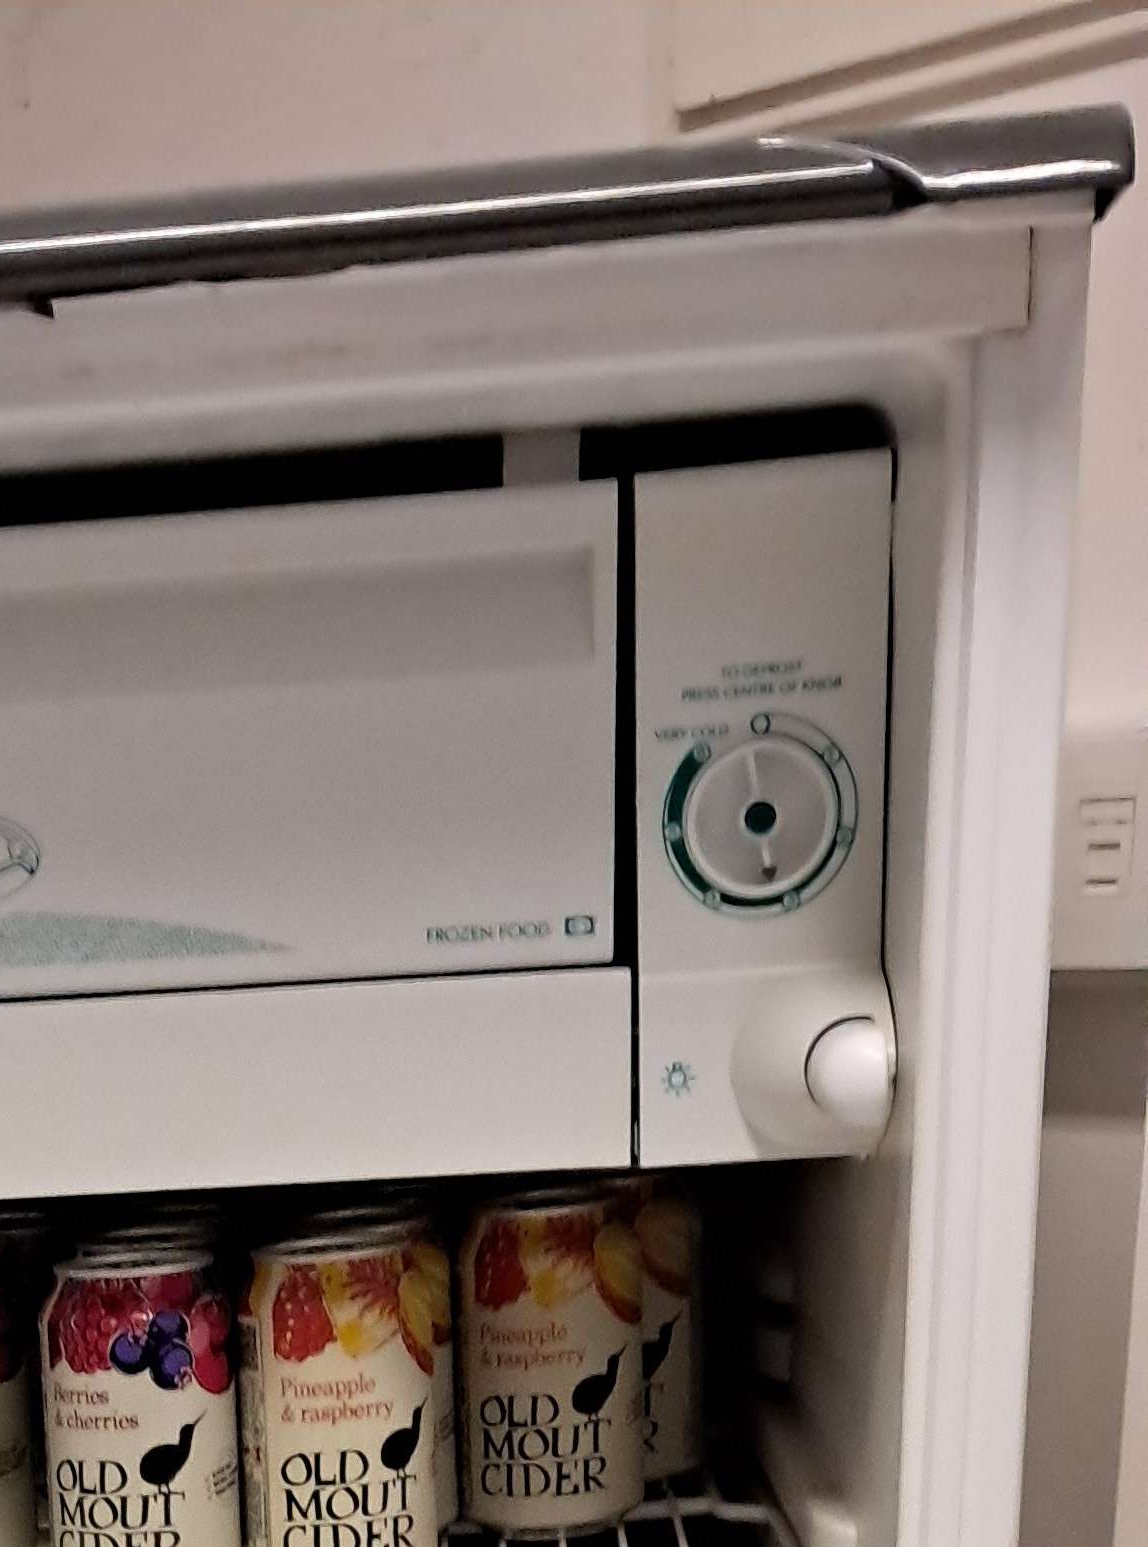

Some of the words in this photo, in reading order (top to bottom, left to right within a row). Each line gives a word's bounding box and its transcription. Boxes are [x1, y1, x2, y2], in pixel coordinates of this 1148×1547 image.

[426, 925, 493, 944] FROZEN
[497, 920, 550, 939] FOOD
[480, 1321, 568, 1347] Pineapple
[496, 1345, 587, 1371] raspberry
[55, 1383, 109, 1405] Berries
[281, 1373, 377, 1399] Pineapple
[66, 1409, 139, 1431] cherries
[281, 1404, 297, 1423] &
[301, 1400, 393, 1426] raspberry
[479, 1394, 560, 1428] OLD
[482, 1417, 612, 1460] MOUT
[56, 1459, 128, 1495] OLD
[280, 1449, 370, 1487] OLD
[480, 1456, 607, 1498] CIDER
[59, 1488, 186, 1530] MOUT
[284, 1473, 417, 1522] MOUT
